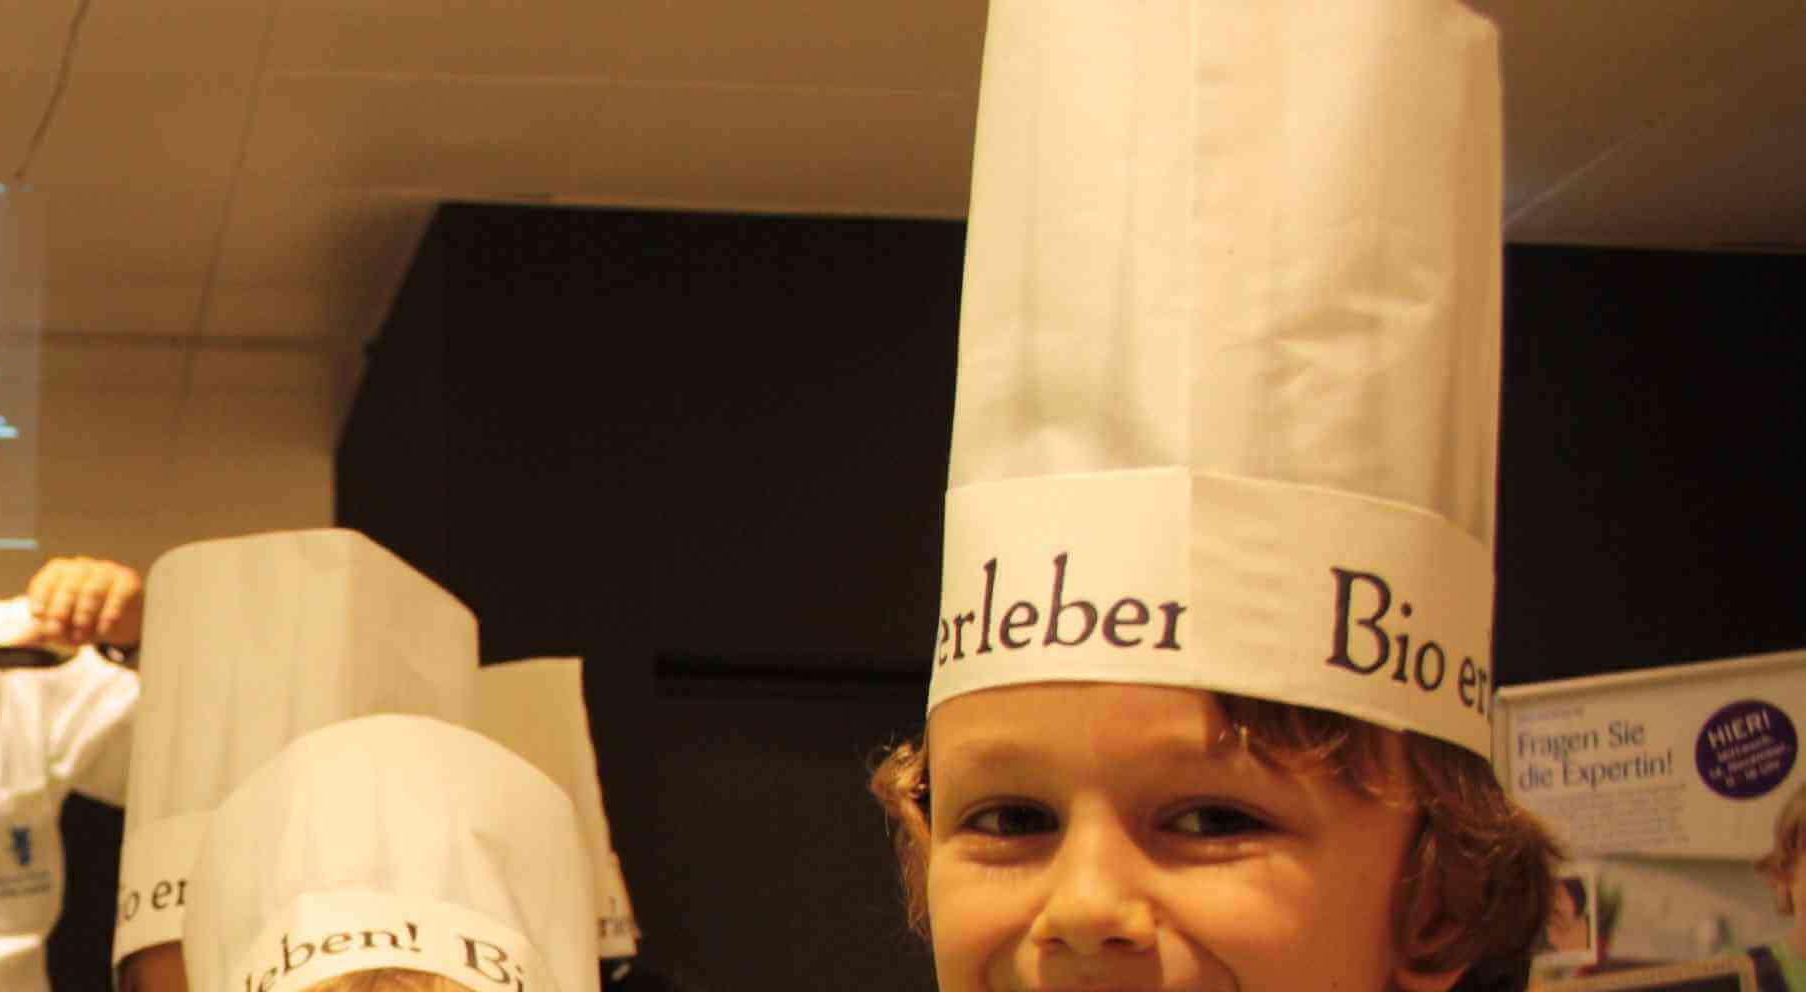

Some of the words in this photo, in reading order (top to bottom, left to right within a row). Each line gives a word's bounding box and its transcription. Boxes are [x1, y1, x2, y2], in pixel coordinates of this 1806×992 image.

[1326, 566, 1446, 692] Bio
[1517, 727, 1600, 760] Fragen
[1608, 720, 1646, 748] Sie
[1518, 760, 1554, 790] die
[1563, 751, 1674, 792] Expertin!
